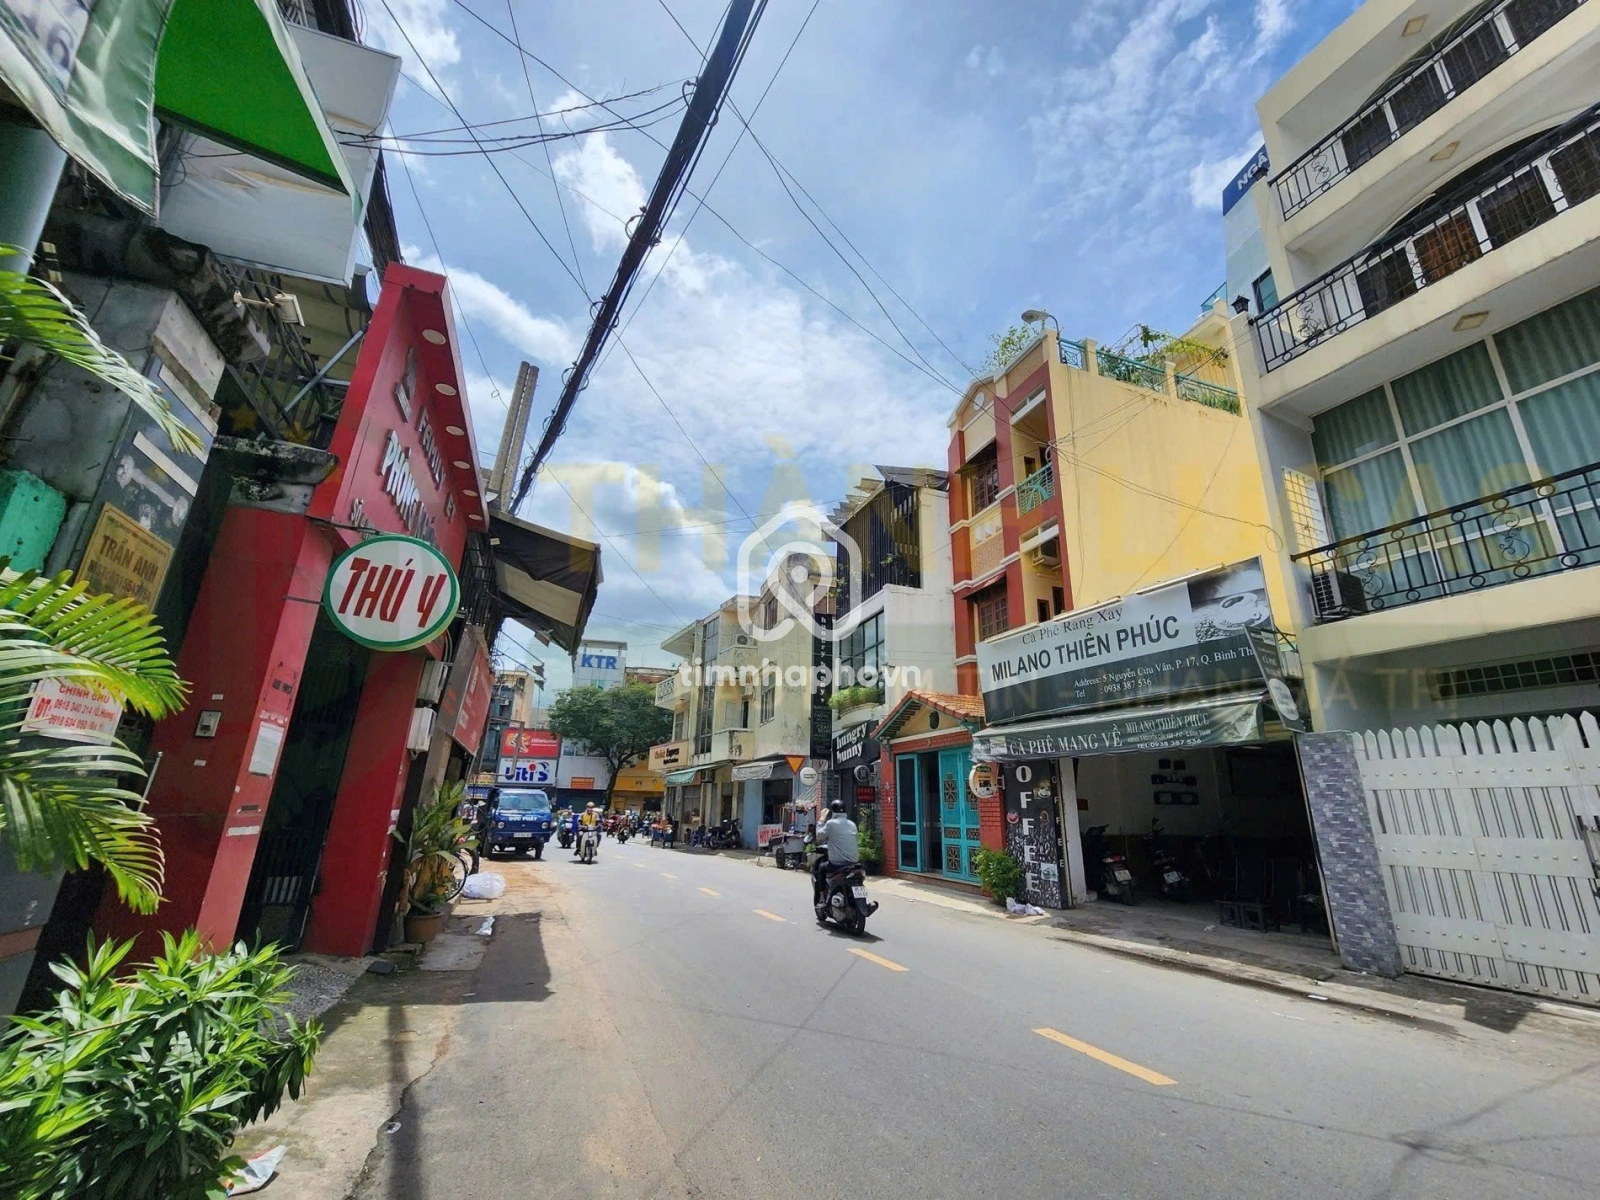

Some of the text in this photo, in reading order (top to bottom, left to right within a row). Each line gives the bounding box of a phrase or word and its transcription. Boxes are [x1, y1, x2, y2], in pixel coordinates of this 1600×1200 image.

[338, 558, 447, 629] THÚ Y
[1022, 608, 1123, 646] Cà Phê Rang Xay
[581, 653, 619, 670] KTR
[991, 614, 1180, 682] MILANO THIÊN PHÚC
[1074, 676, 1101, 688] Address:
[1239, 646, 1254, 659] Th
[1074, 689, 1086, 699] Tel
[836, 722, 868, 750] hungry
[1125, 710, 1209, 734] MILANO THIÊN PHÚC
[836, 741, 864, 765] bunny
[1010, 723, 1123, 756] CÀ PHÊ MANG VỀ
[1170, 739, 1185, 747] 387
[1186, 737, 1202, 746] 536
[1015, 765, 1042, 896] OFFEE
